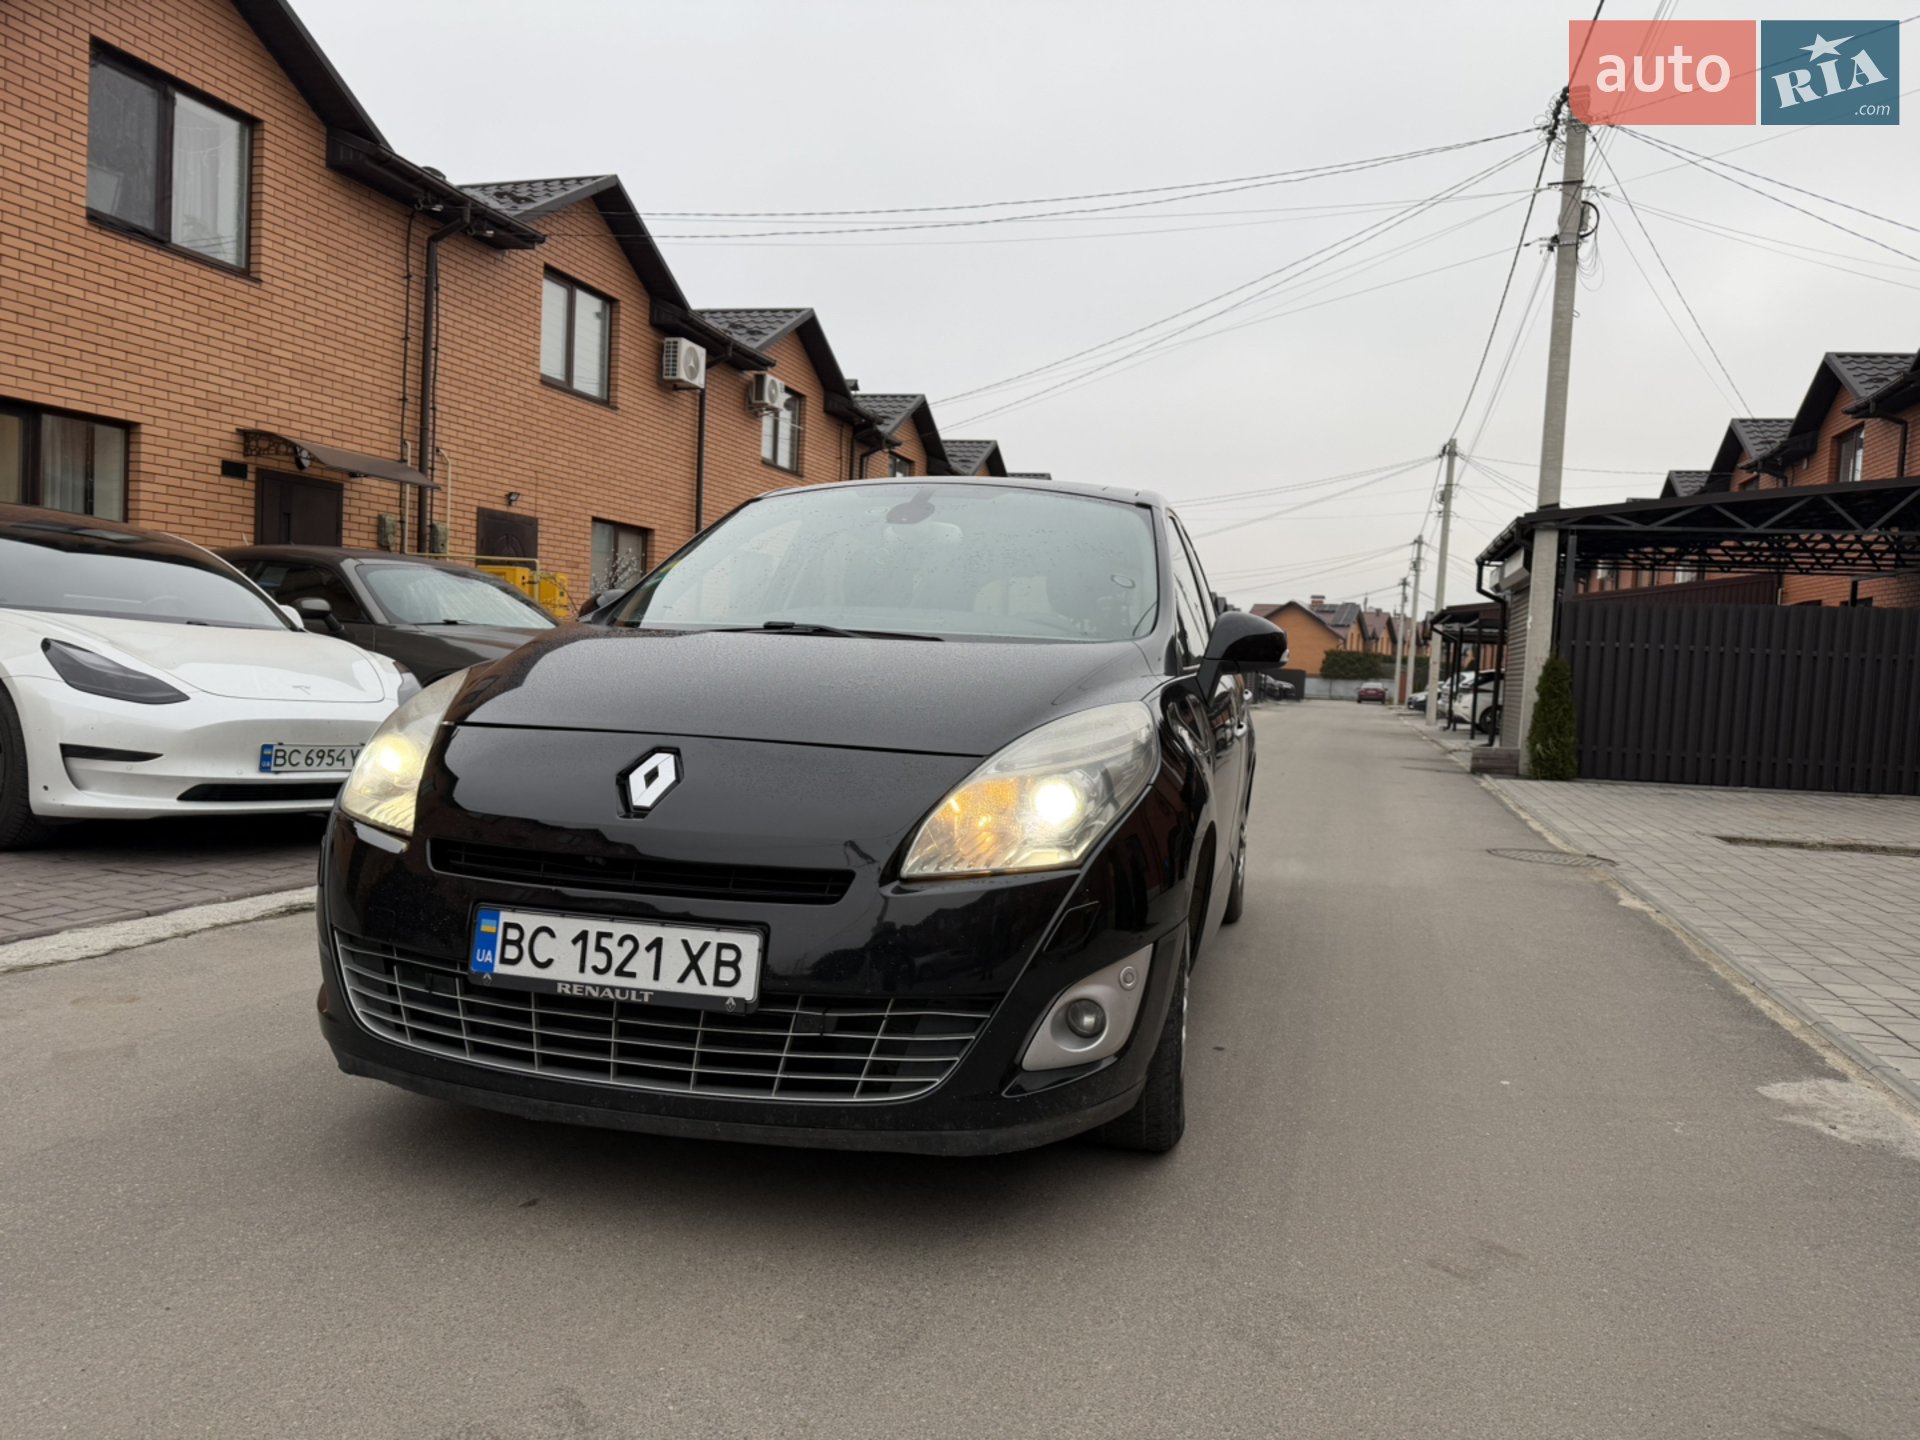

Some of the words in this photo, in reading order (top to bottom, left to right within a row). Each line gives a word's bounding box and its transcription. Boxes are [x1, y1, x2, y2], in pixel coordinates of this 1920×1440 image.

[273, 748, 301, 767] BC
[304, 748, 346, 767] 6954
[476, 948, 493, 964] UA
[499, 921, 557, 970] BC
[570, 929, 664, 982] 1521
[676, 938, 743, 988] XB
[556, 982, 654, 1003] RENAULT
